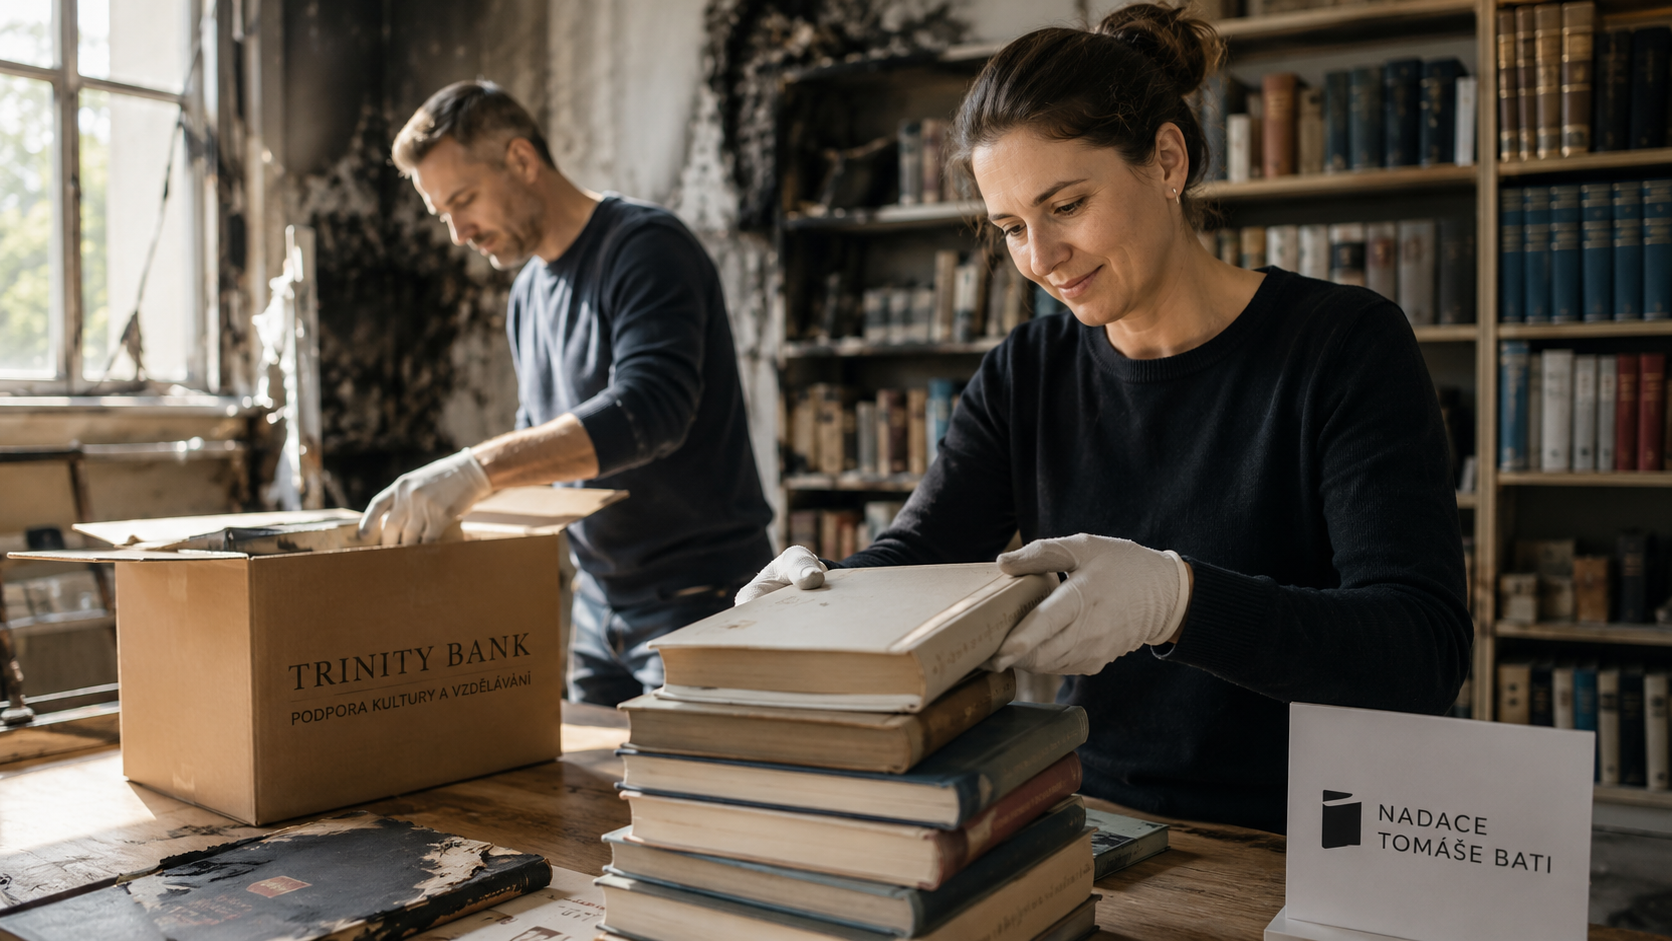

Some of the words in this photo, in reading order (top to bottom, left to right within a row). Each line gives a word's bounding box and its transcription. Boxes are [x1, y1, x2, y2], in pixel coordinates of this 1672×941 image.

[288, 645, 434, 691] TRINITY
[446, 632, 531, 667] BANK
[291, 702, 368, 726] PODPORA
[372, 689, 436, 712] KULTURY
[439, 687, 449, 700] A
[452, 670, 532, 697] VZDĚLÁVÁNÍ
[1378, 803, 1488, 836] NADACE
[1377, 831, 1483, 864] TOMÁŠE
[1494, 848, 1552, 874] BATI
